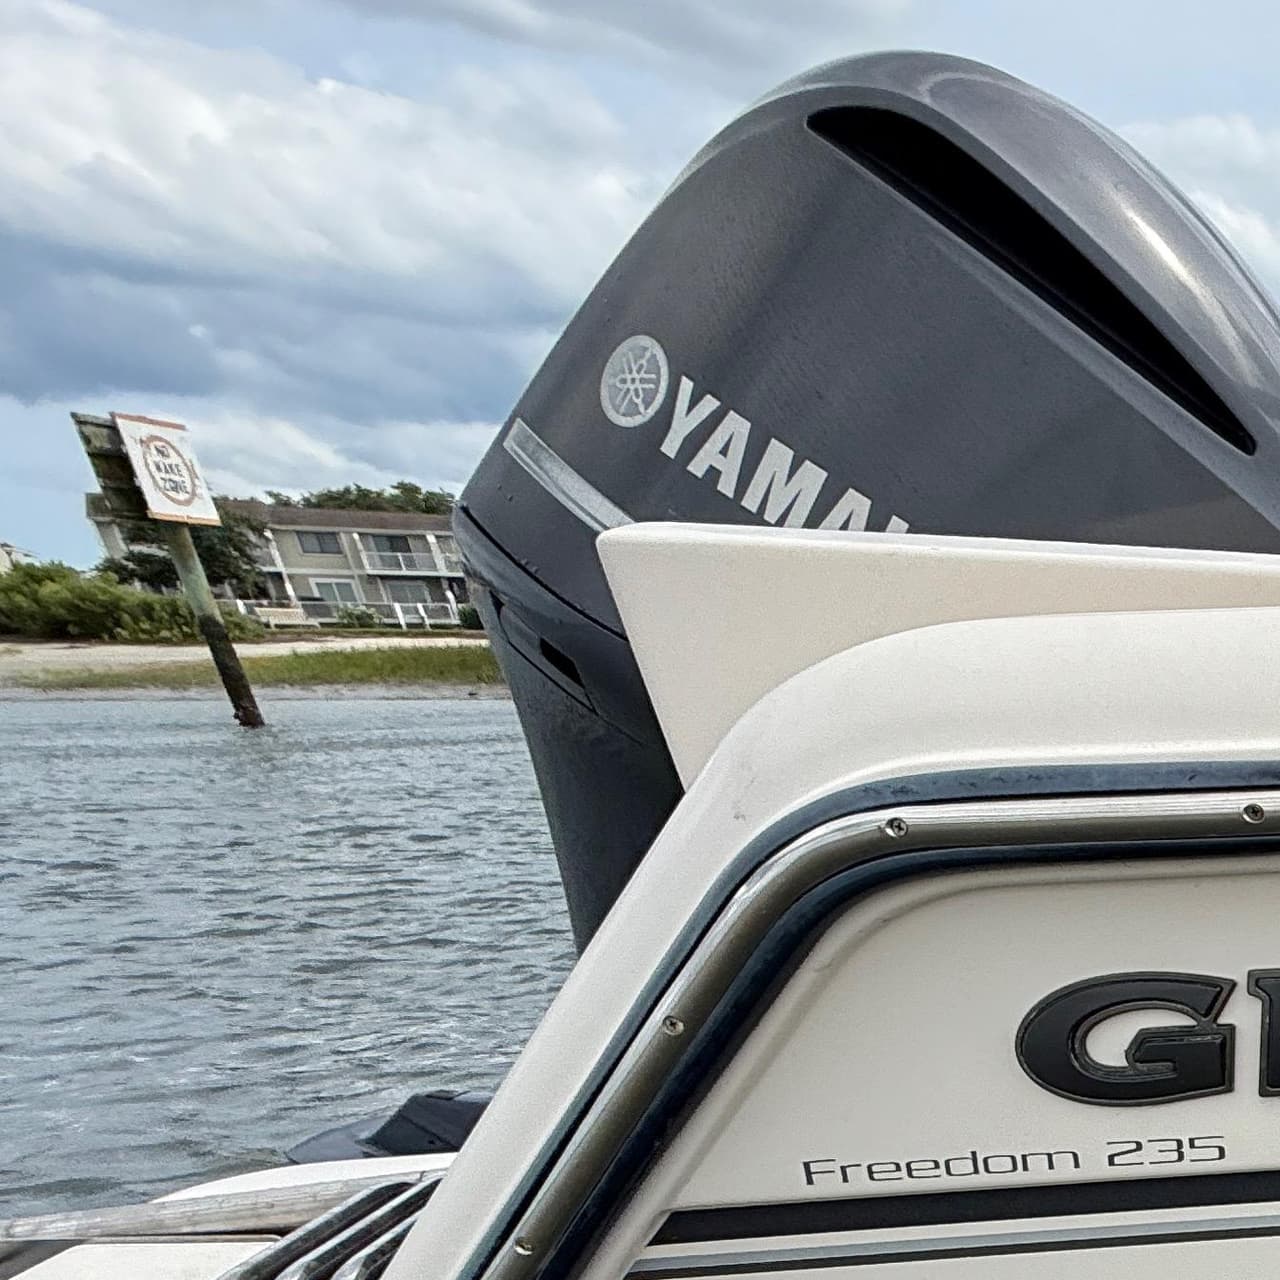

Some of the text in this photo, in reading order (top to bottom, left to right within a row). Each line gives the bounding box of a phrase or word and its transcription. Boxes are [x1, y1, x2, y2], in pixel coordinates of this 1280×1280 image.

[153, 461, 186, 478] WAKE
[660, 375, 910, 534] YAM
[160, 477, 190, 494] ZONE
[802, 1135, 1226, 1186] Freedom 235
